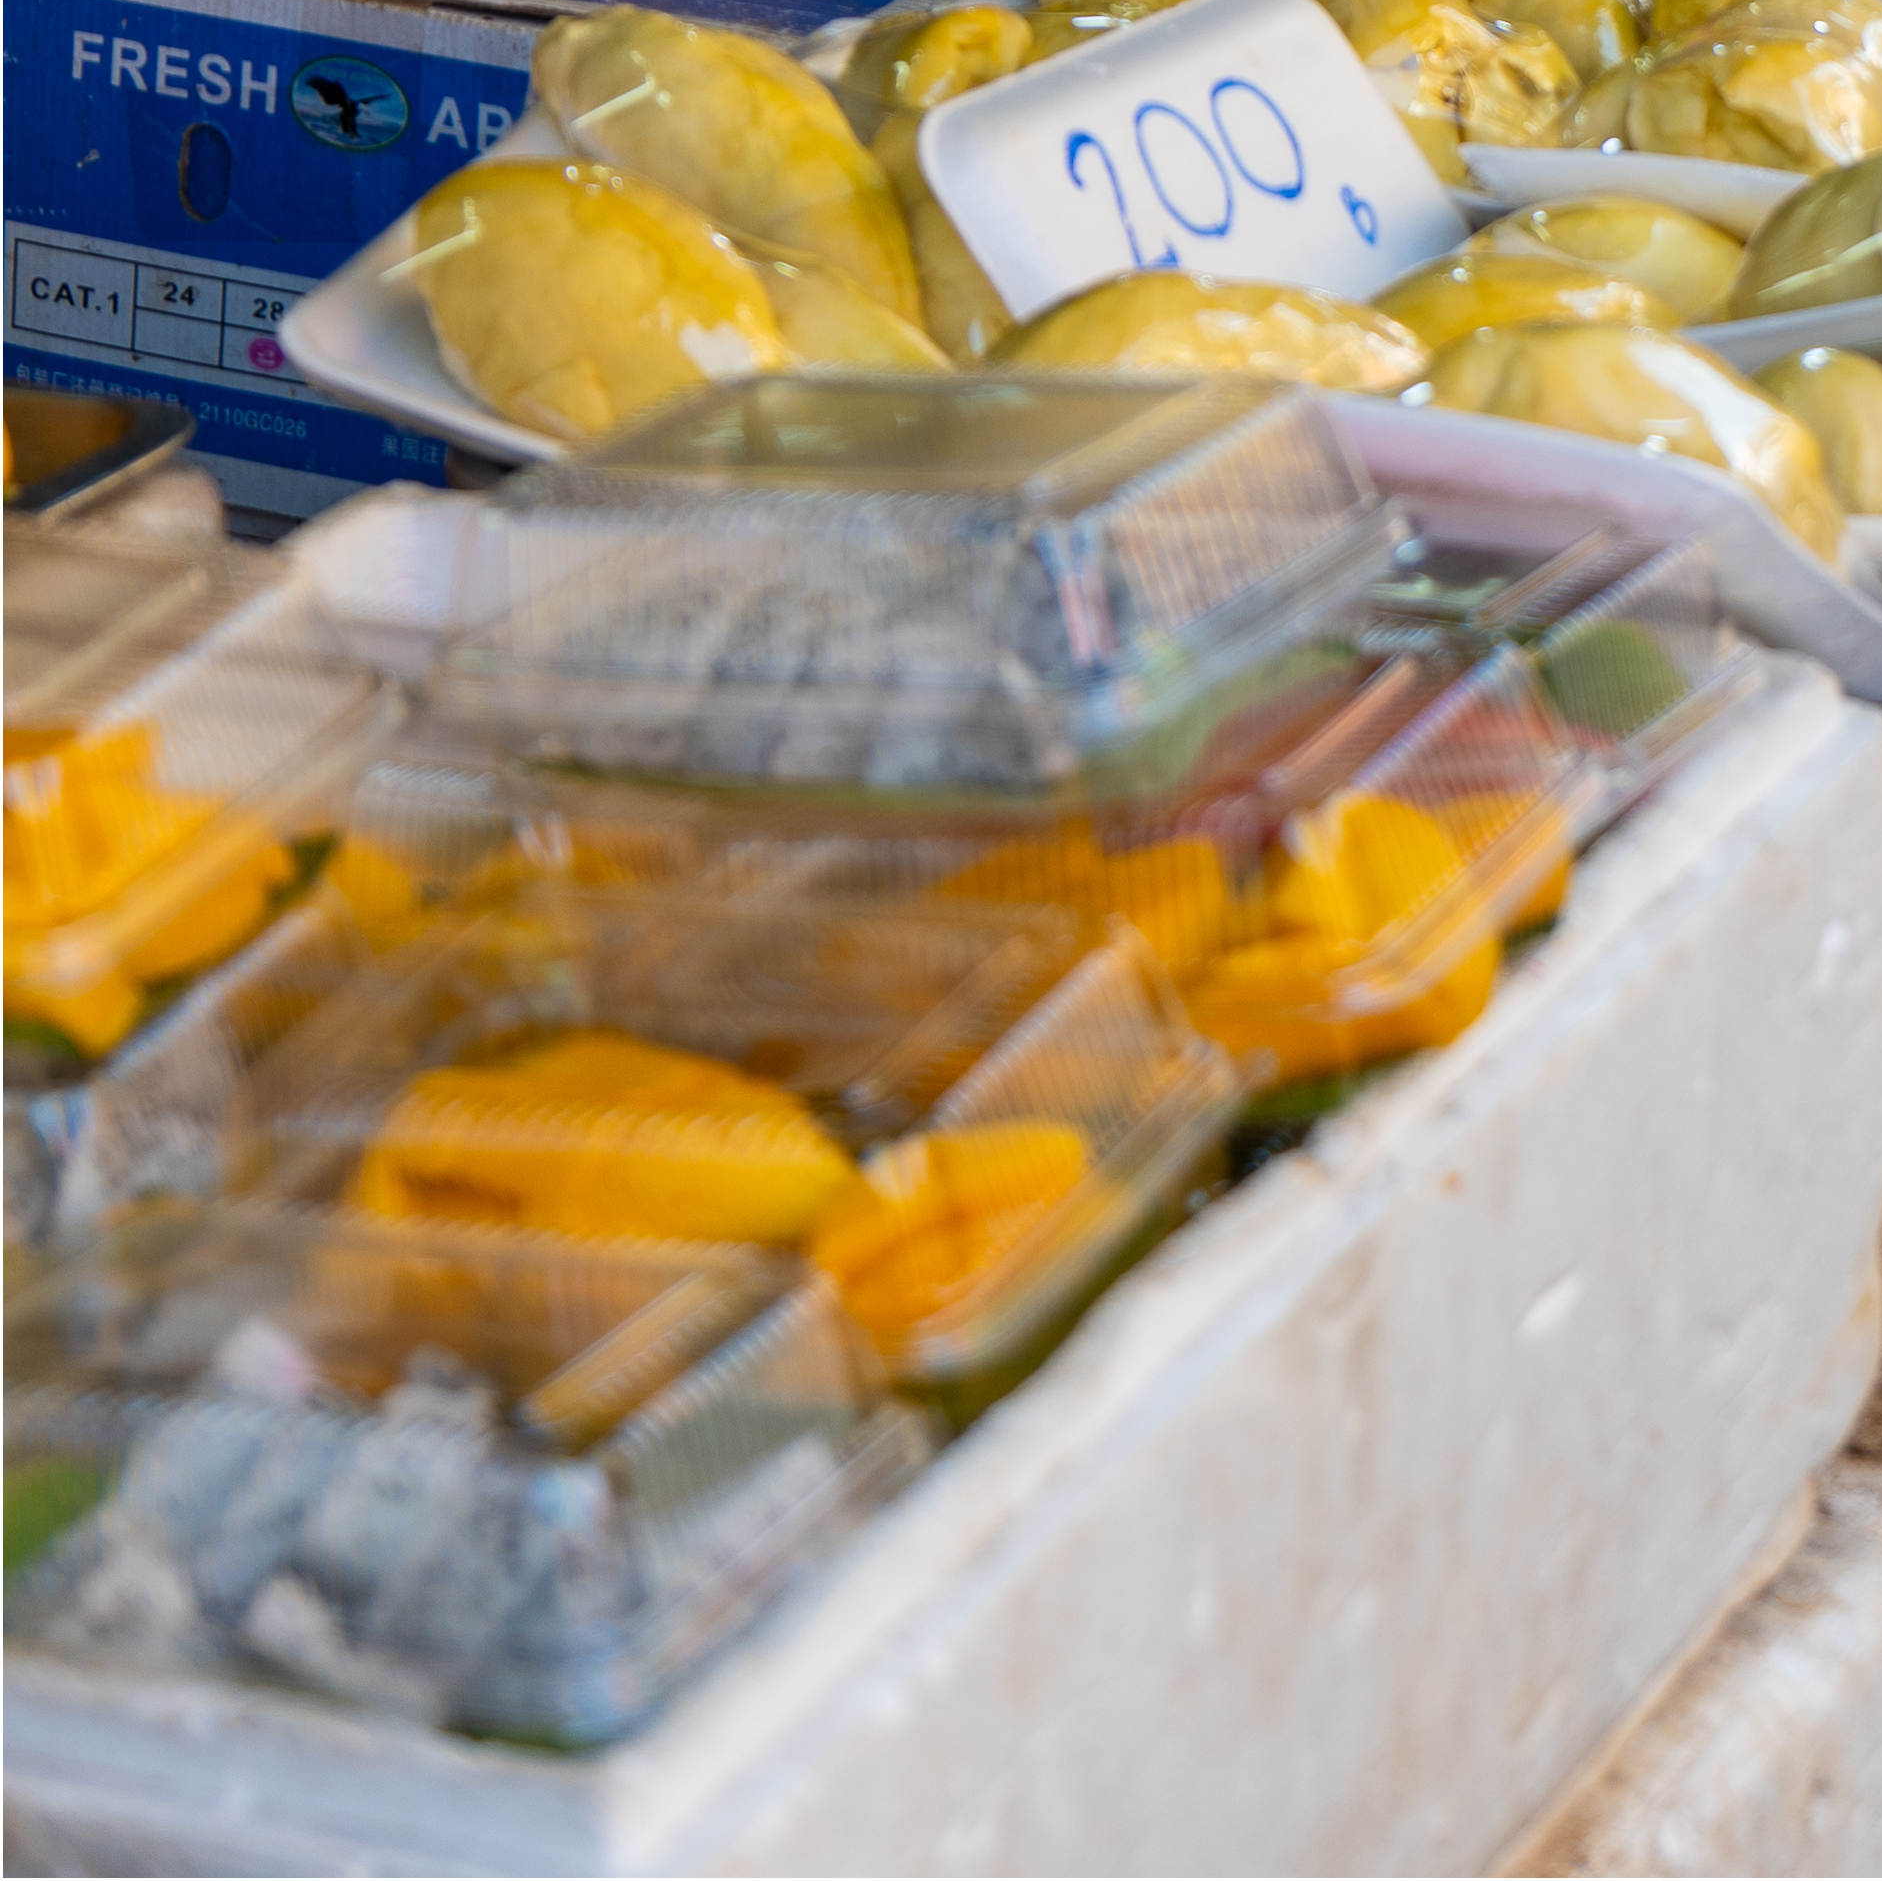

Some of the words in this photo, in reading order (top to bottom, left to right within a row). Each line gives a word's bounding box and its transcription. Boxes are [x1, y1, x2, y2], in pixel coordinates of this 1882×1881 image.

[72, 30, 279, 114] FRESH
[1065, 75, 1306, 270] 200
[29, 275, 122, 316] CAT.1
[162, 281, 196, 305] 24
[252, 297, 285, 323] 28
[198, 401, 308, 440] 2110GC026
[380, 433, 447, 465] 果园注
